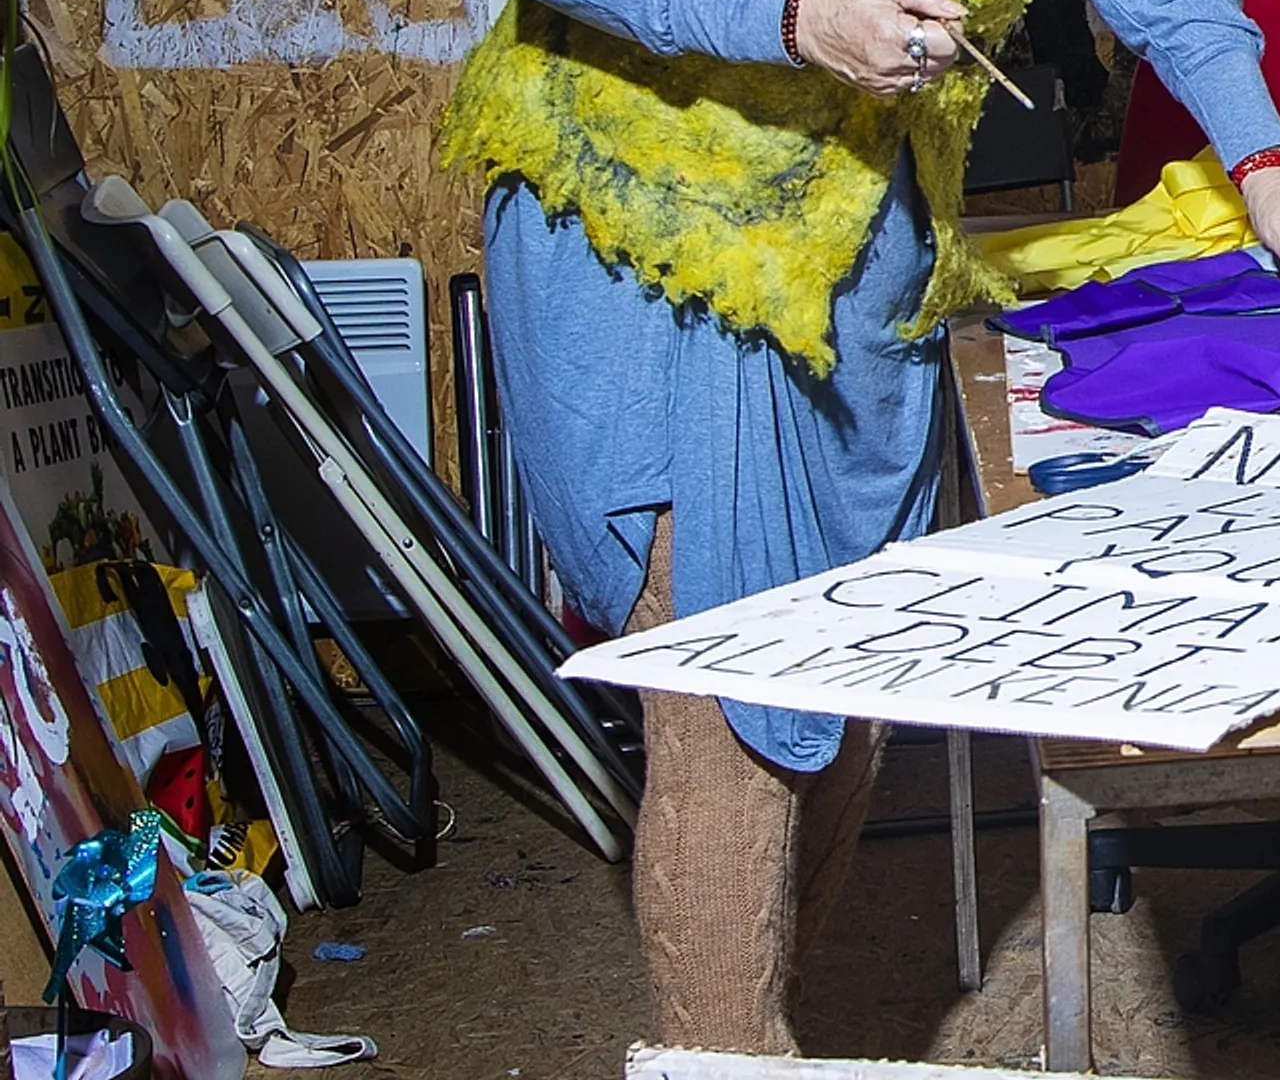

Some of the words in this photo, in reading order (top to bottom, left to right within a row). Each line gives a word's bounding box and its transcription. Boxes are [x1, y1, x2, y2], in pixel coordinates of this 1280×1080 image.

[0, 357, 85, 409] TRANSITIO
[11, 432, 26, 473] A
[28, 418, 82, 468] PLANT
[844, 620, 1247, 677] DEBT
